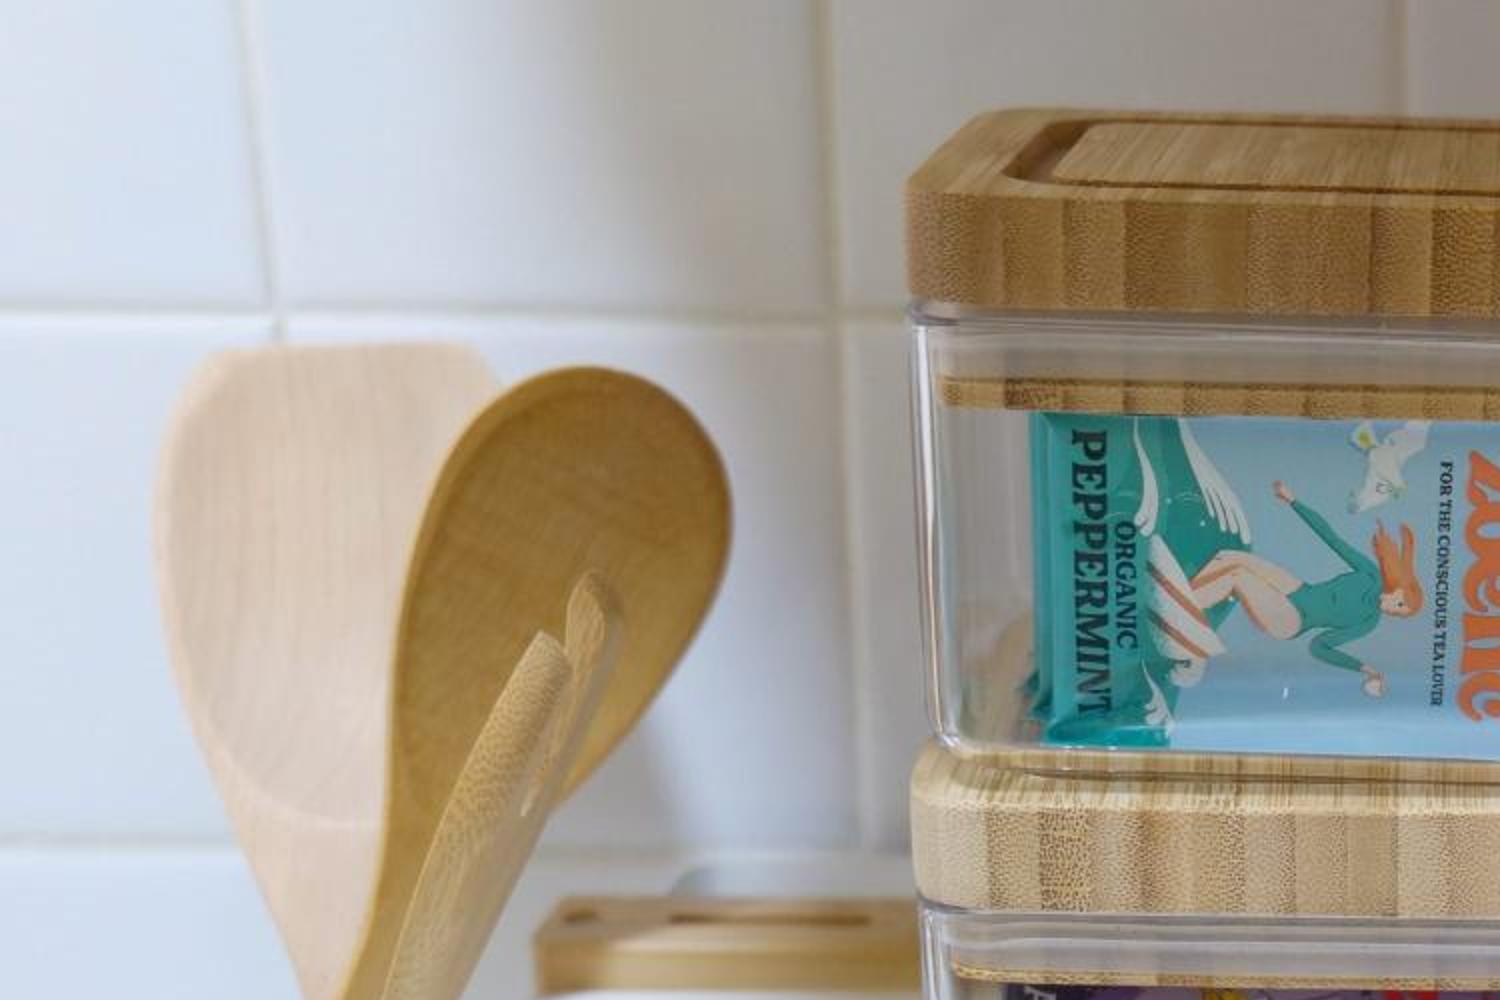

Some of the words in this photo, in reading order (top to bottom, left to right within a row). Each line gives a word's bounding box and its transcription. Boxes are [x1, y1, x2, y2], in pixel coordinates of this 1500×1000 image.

[1440, 461, 1453, 494] FOR
[1438, 498, 1452, 533] THE
[1071, 430, 1112, 714] PEPPERMINT
[1115, 521, 1138, 649] ORGANIC
[1434, 535, 1451, 631] CONSCIOUS
[1433, 632, 1446, 662] TEA
[1431, 665, 1444, 707] LOVER
